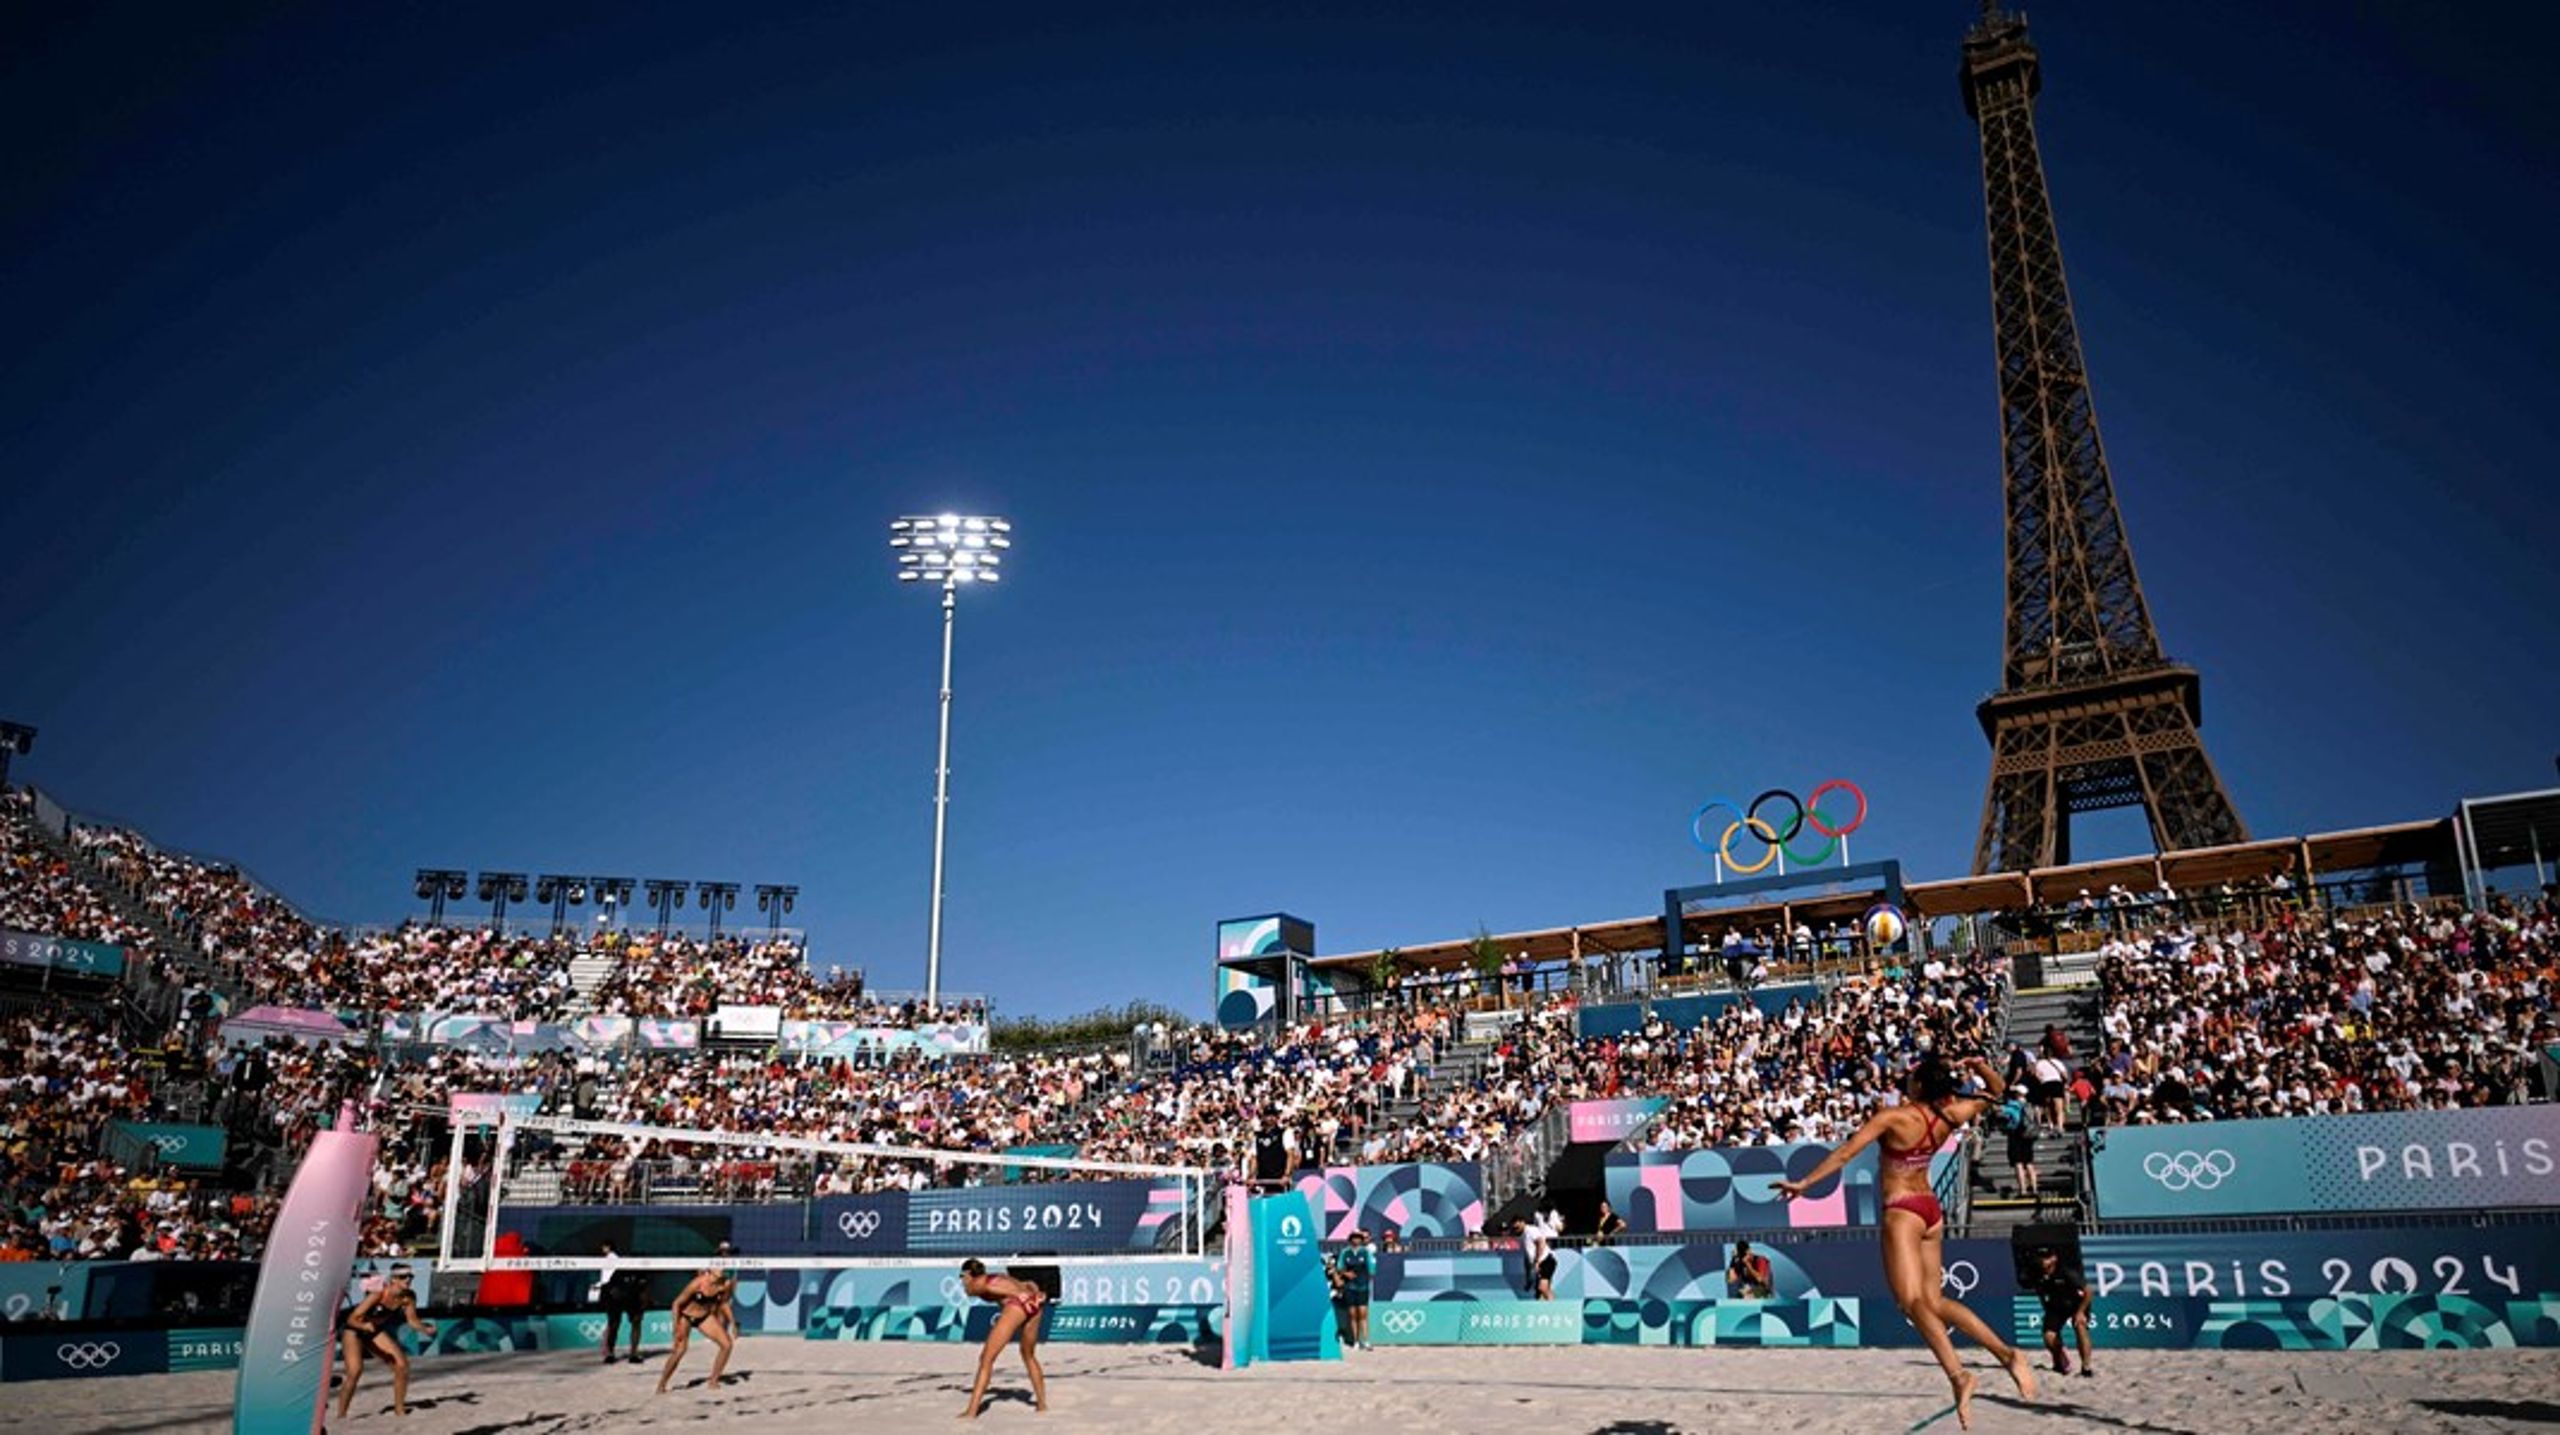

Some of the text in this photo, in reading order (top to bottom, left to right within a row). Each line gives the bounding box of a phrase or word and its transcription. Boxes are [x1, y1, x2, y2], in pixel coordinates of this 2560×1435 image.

[28, 941, 95, 965] 2024
[929, 1202, 1102, 1233] PARIS 2024
[301, 1220, 330, 1282] 2024
[2321, 1255, 2520, 1296] 2024
[2107, 1313, 2173, 1329] 2024
[182, 1341, 244, 1357] PARIS
